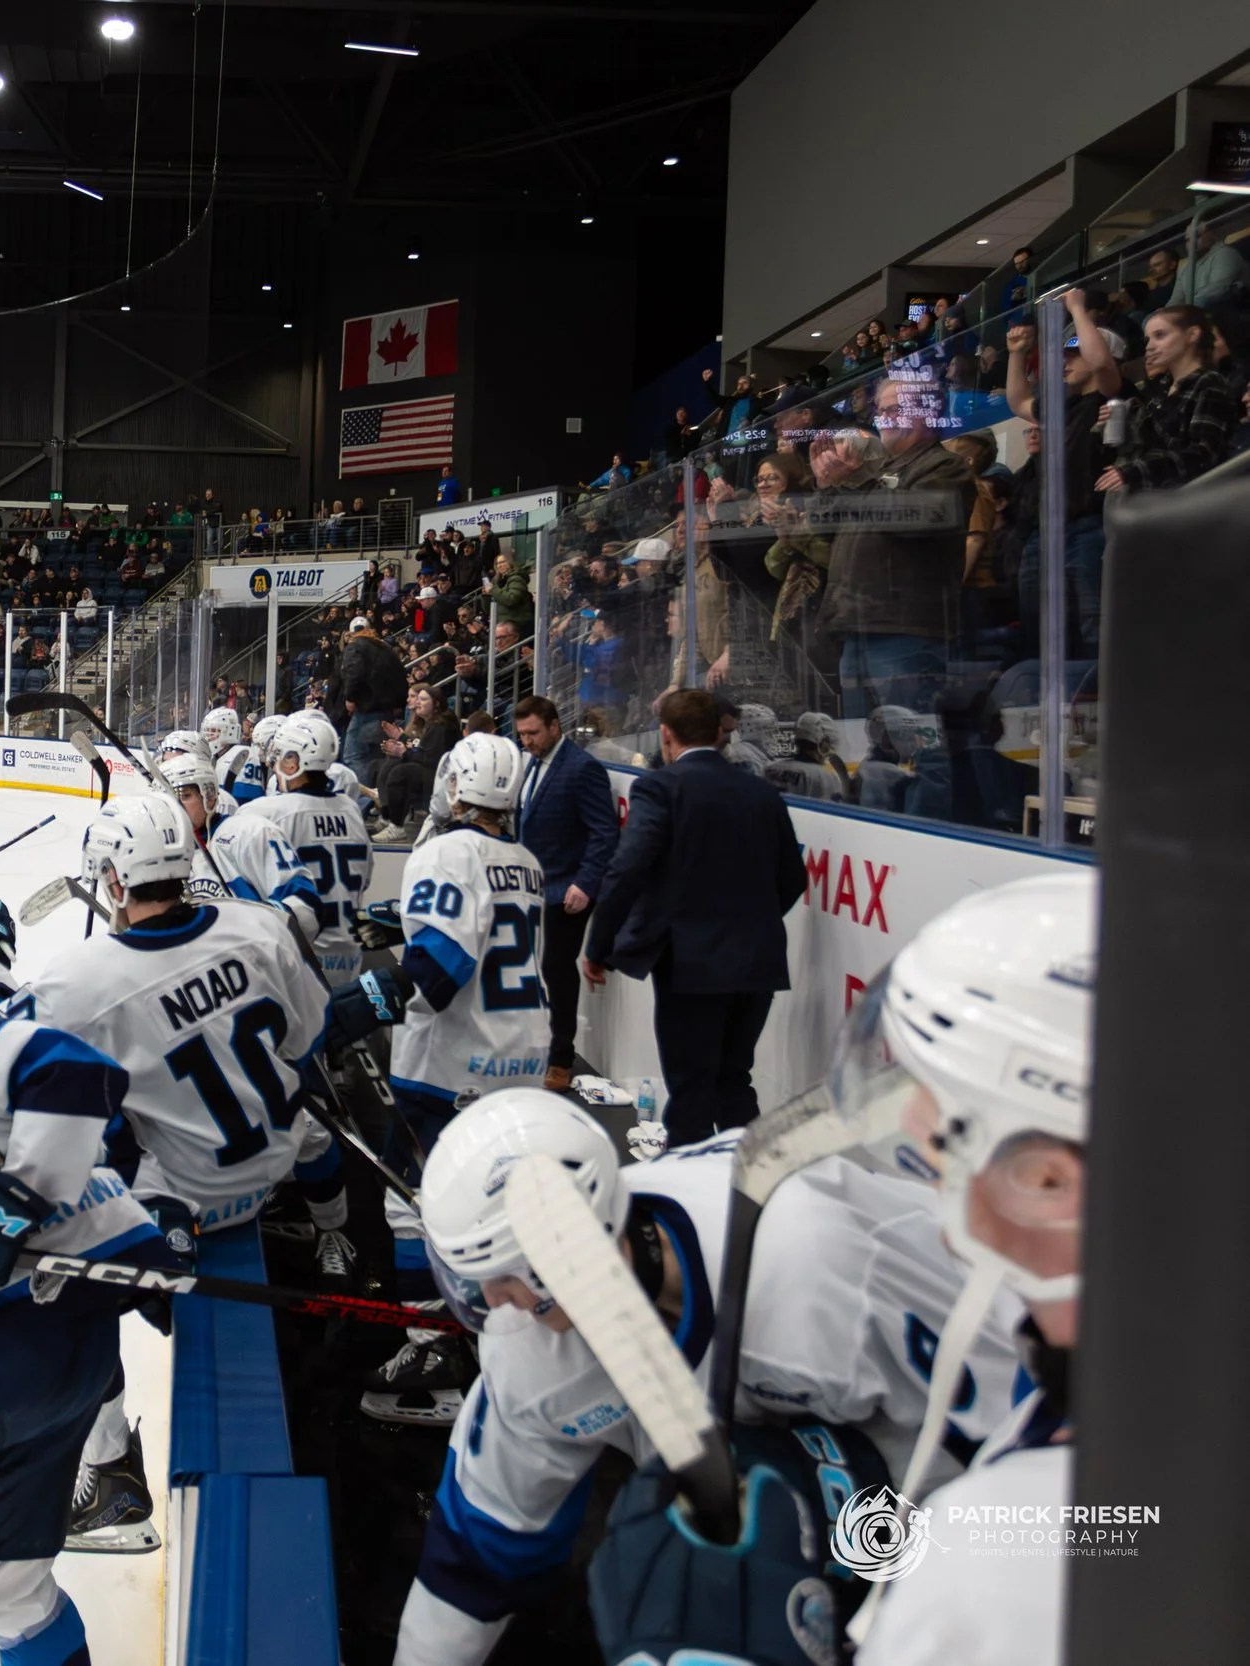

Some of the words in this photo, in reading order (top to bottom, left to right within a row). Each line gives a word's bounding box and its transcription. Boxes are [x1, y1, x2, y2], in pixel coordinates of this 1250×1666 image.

[537, 497, 553, 507] 116
[446, 517, 476, 528] ANYTIME
[488, 509, 523, 520] FITNESS
[276, 569, 324, 587] TALBOT
[20, 750, 56, 761] COLDWELL
[58, 754, 83, 764] BANKER
[244, 763, 262, 781] 30
[163, 828, 176, 845] 10
[313, 815, 348, 838] HAN
[407, 878, 464, 919] 20
[158, 957, 250, 1032] NOAD
[164, 995, 305, 1167] 10
[1016, 1066, 1083, 1102] CC
[35, 1255, 199, 1294] CCM
